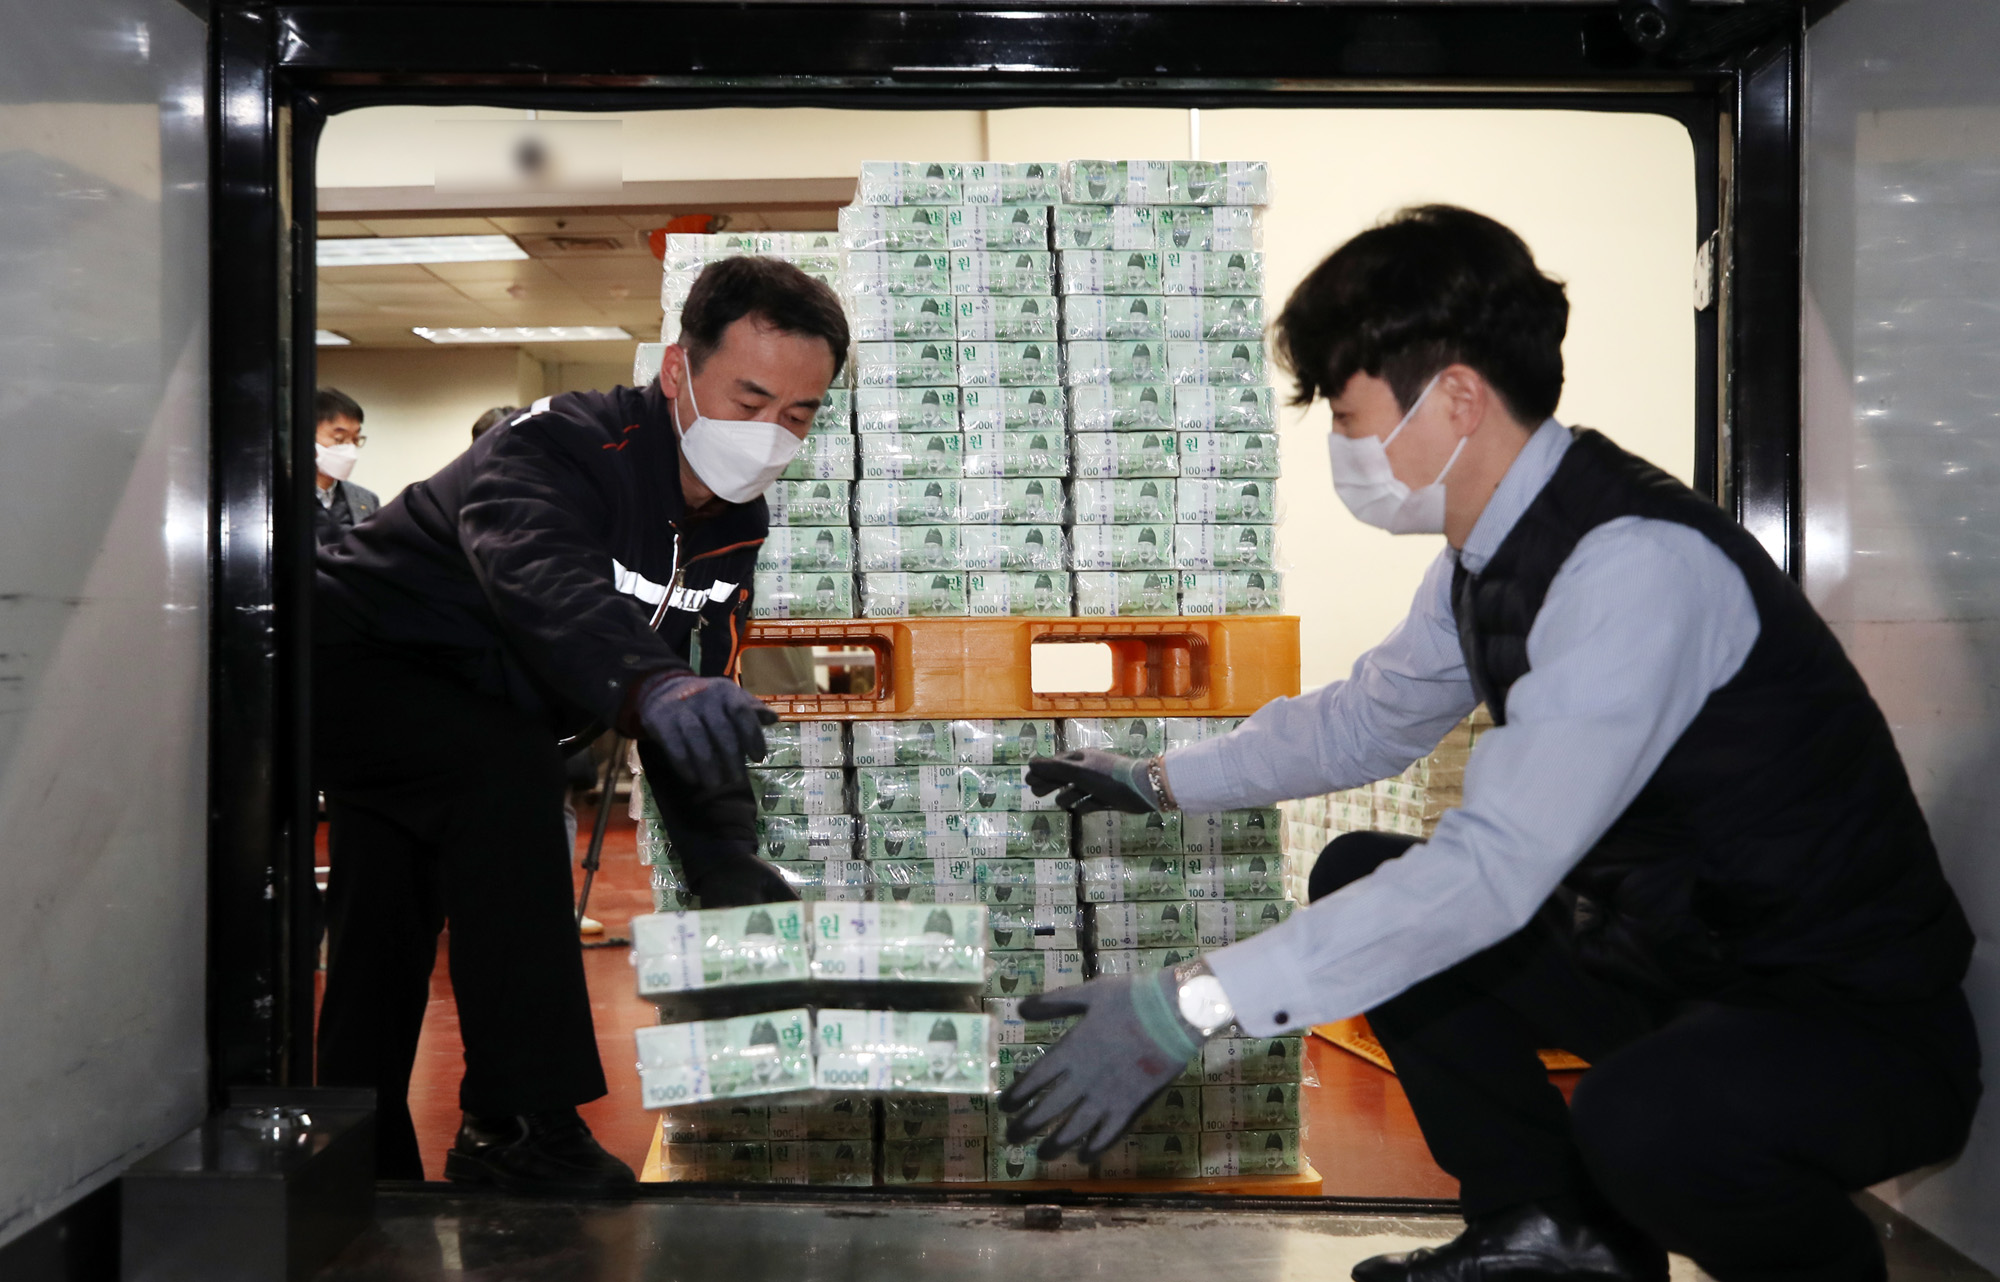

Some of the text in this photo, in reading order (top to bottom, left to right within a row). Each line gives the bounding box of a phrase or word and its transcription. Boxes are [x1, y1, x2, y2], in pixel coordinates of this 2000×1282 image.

[972, 166, 984, 180] 원
[967, 195, 989, 203] 1000
[950, 210, 962, 226] 원
[958, 256, 971, 271] 원
[1144, 252, 1180, 269] 만 원
[938, 302, 973, 317] 만 원
[939, 345, 976, 361] 만 원
[966, 391, 979, 407] 원
[945, 434, 982, 451] 만 원
[1161, 436, 1198, 453] 만 원
[866, 467, 882, 475] 100
[1083, 467, 1098, 476] 100
[1185, 467, 1200, 475] 100
[1181, 512, 1196, 520] 100
[965, 560, 986, 568] 1000
[948, 575, 984, 591] 만 원
[1183, 574, 1196, 590] 원
[754, 608, 770, 616] 100
[1083, 606, 1105, 614] 1000
[1186, 604, 1213, 613] 10000
[821, 724, 838, 732] 100
[825, 772, 841, 780] 100
[939, 768, 955, 776] 100
[970, 848, 986, 856] 100
[1086, 845, 1101, 854] 100
[1186, 844, 1202, 852] 100
[846, 863, 862, 871] 100
[1188, 858, 1201, 874] 원
[950, 863, 965, 879] 만
[1089, 891, 1105, 900] 100
[1188, 889, 1205, 897] 100
[820, 915, 839, 939] 원
[1101, 938, 1117, 947] 100
[1200, 936, 1216, 944] 100
[1064, 954, 1079, 963] 100
[821, 1024, 842, 1047] 원
[965, 1139, 980, 1148] 100
[1205, 1166, 1220, 1175] 100
